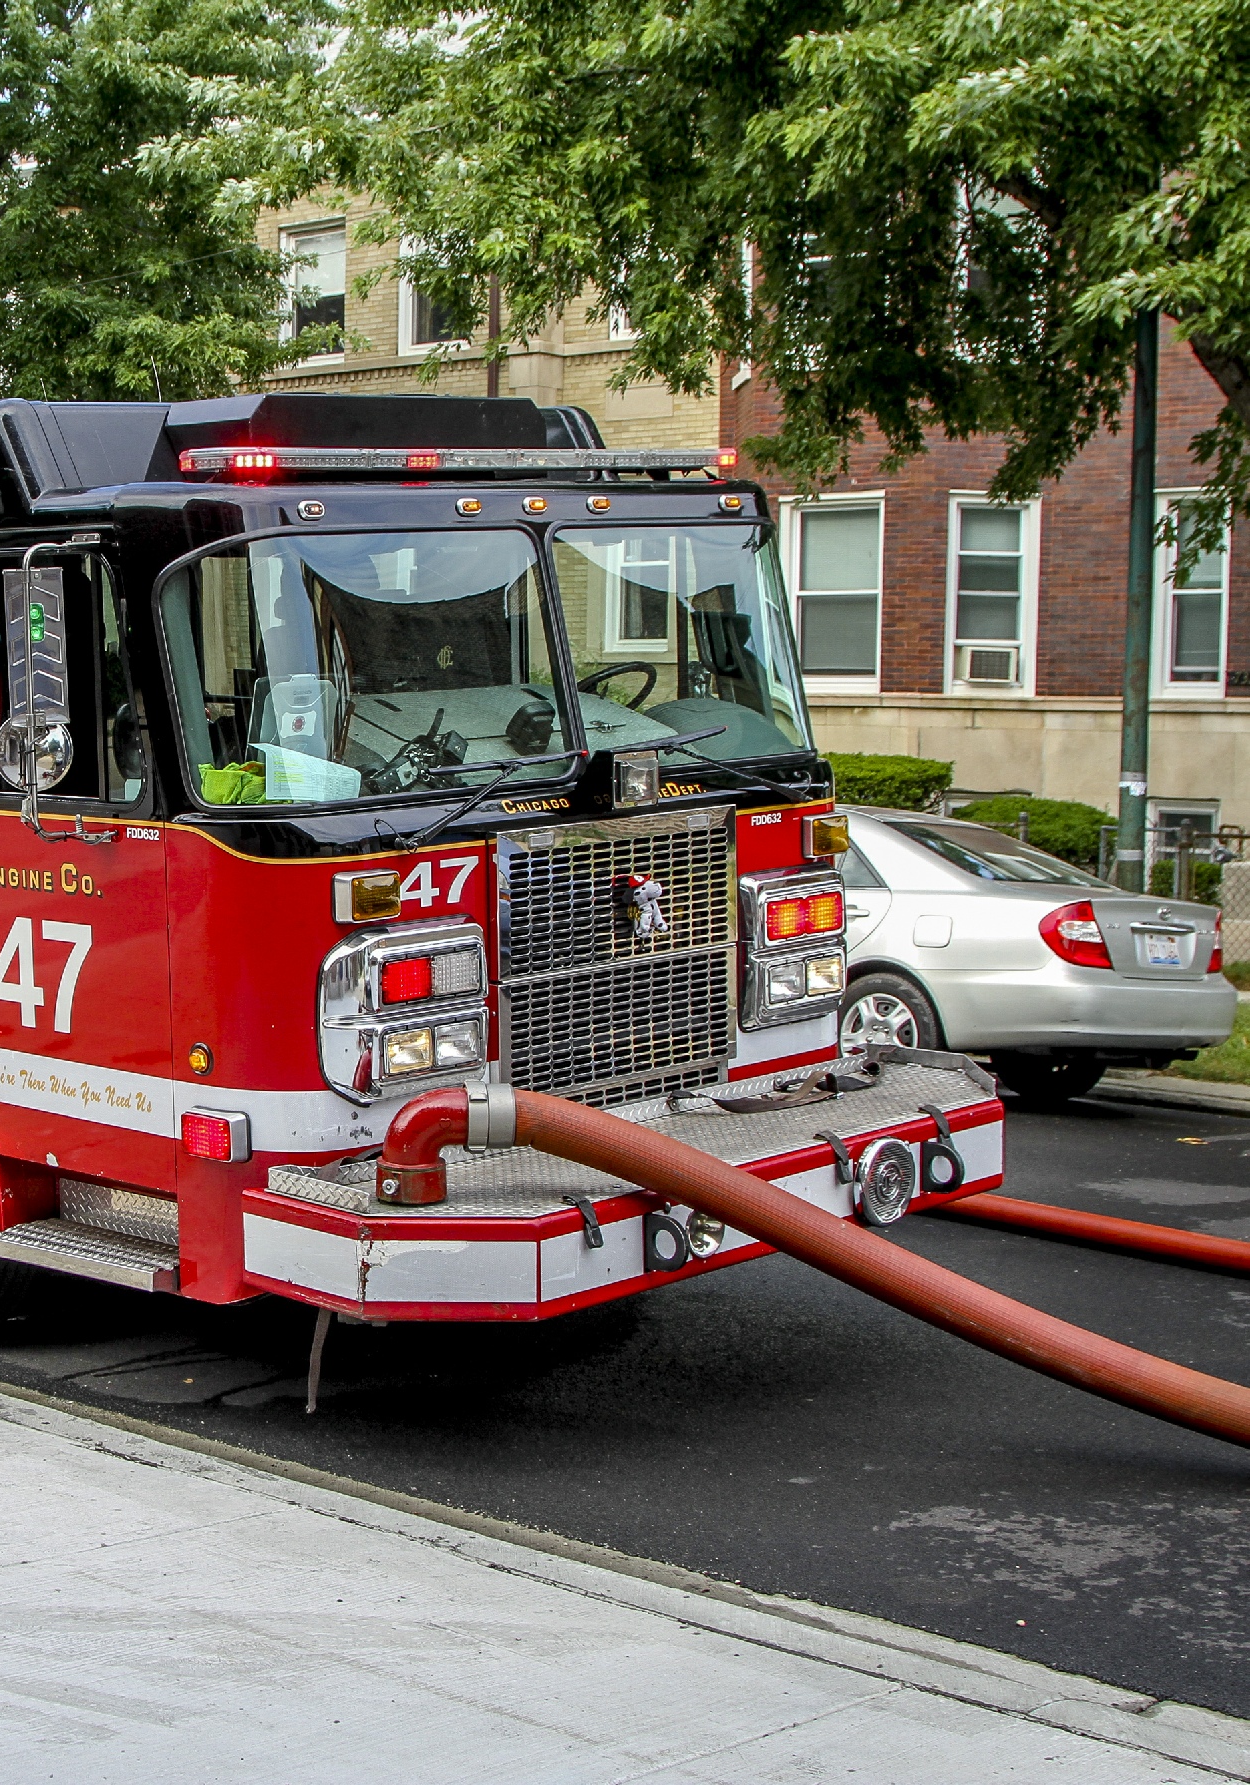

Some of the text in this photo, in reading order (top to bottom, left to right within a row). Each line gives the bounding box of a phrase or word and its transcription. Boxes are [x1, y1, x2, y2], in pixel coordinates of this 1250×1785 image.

[126, 827, 160, 841] FDD632
[751, 812, 782, 827] FDD632
[400, 855, 480, 908] 47
[19, 1069, 47, 1092] There
[50, 1075, 77, 1099] When
[80, 1081, 102, 1109] You
[105, 1085, 132, 1109] Need
[135, 1091, 153, 1114] Us
